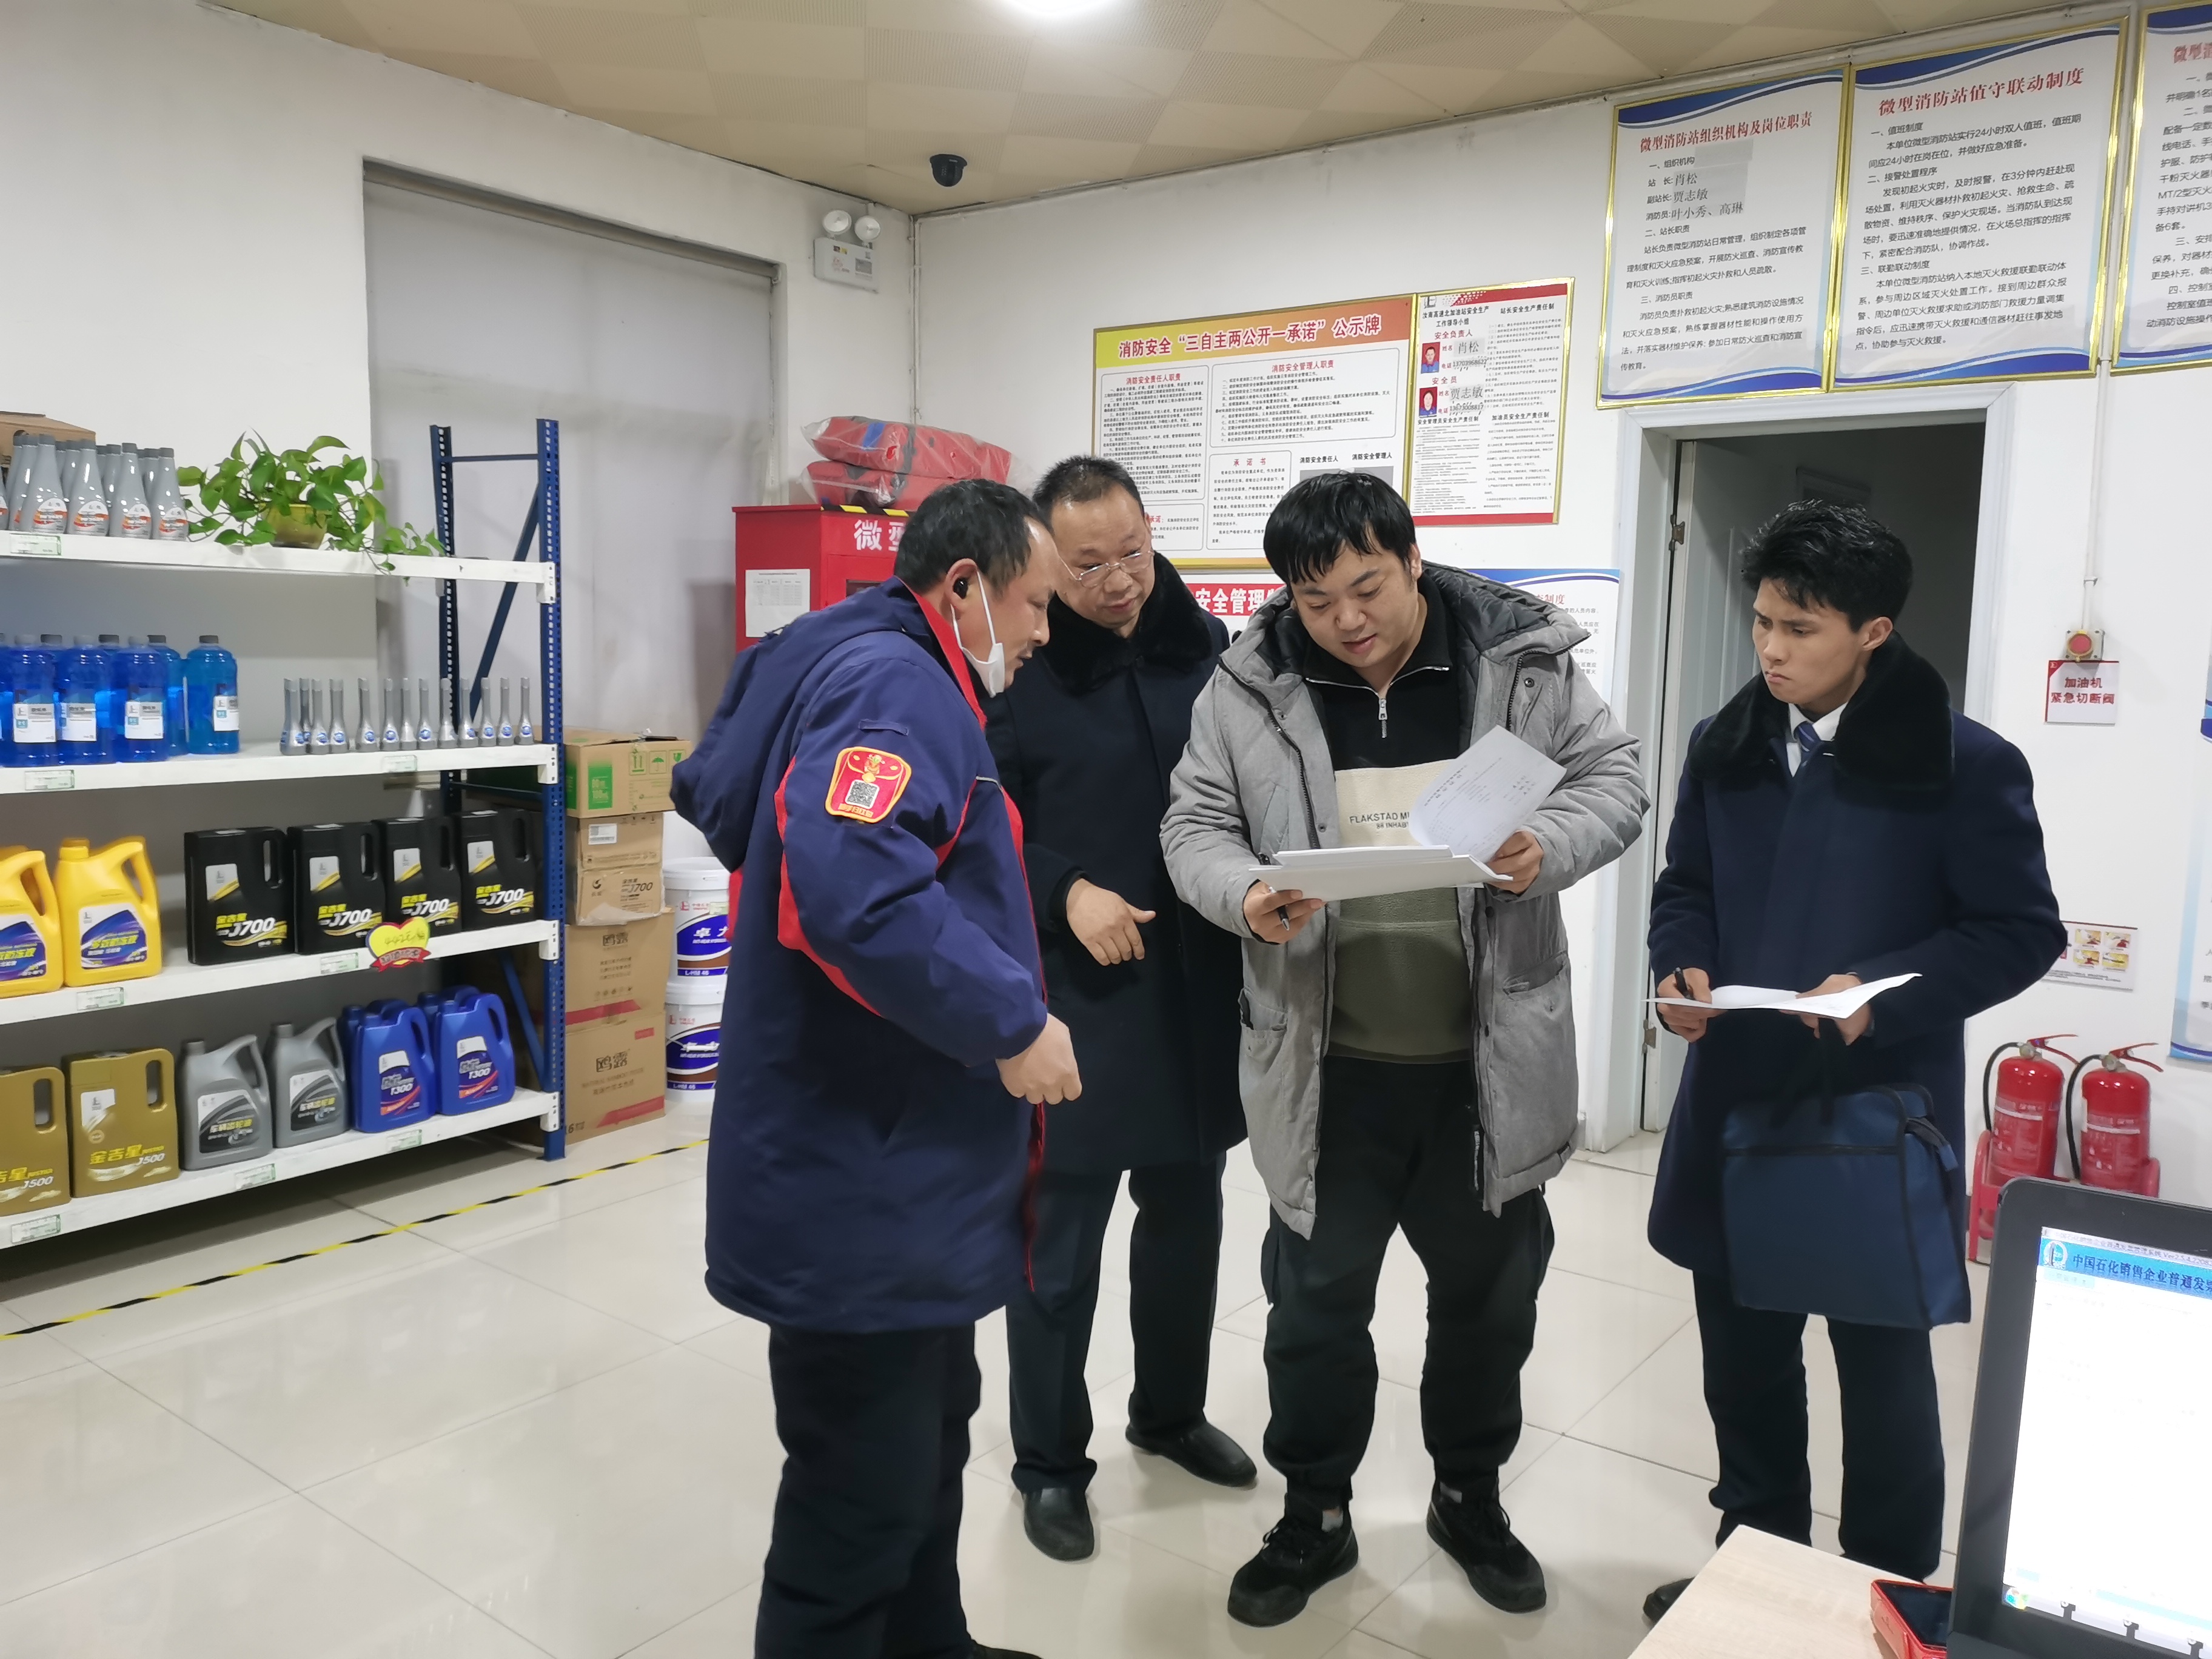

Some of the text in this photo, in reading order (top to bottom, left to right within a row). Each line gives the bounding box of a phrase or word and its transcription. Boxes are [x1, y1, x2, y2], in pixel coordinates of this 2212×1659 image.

[1879, 67, 2085, 116] 微型消防站值守联动制度
[1640, 111, 1813, 153] 微型消防站组织机构及岗位职责
[1435, 329, 1473, 340] 安全负责人
[1458, 340, 1480, 354] 肖松
[2064, 677, 2103, 689] 加油机
[2051, 692, 2116, 705] 紧急切断阀
[1349, 811, 1410, 825] FLAKSTAD M
[485, 888, 525, 906] J700
[411, 898, 450, 916] J700
[329, 908, 373, 927] J700
[228, 917, 276, 937] J700
